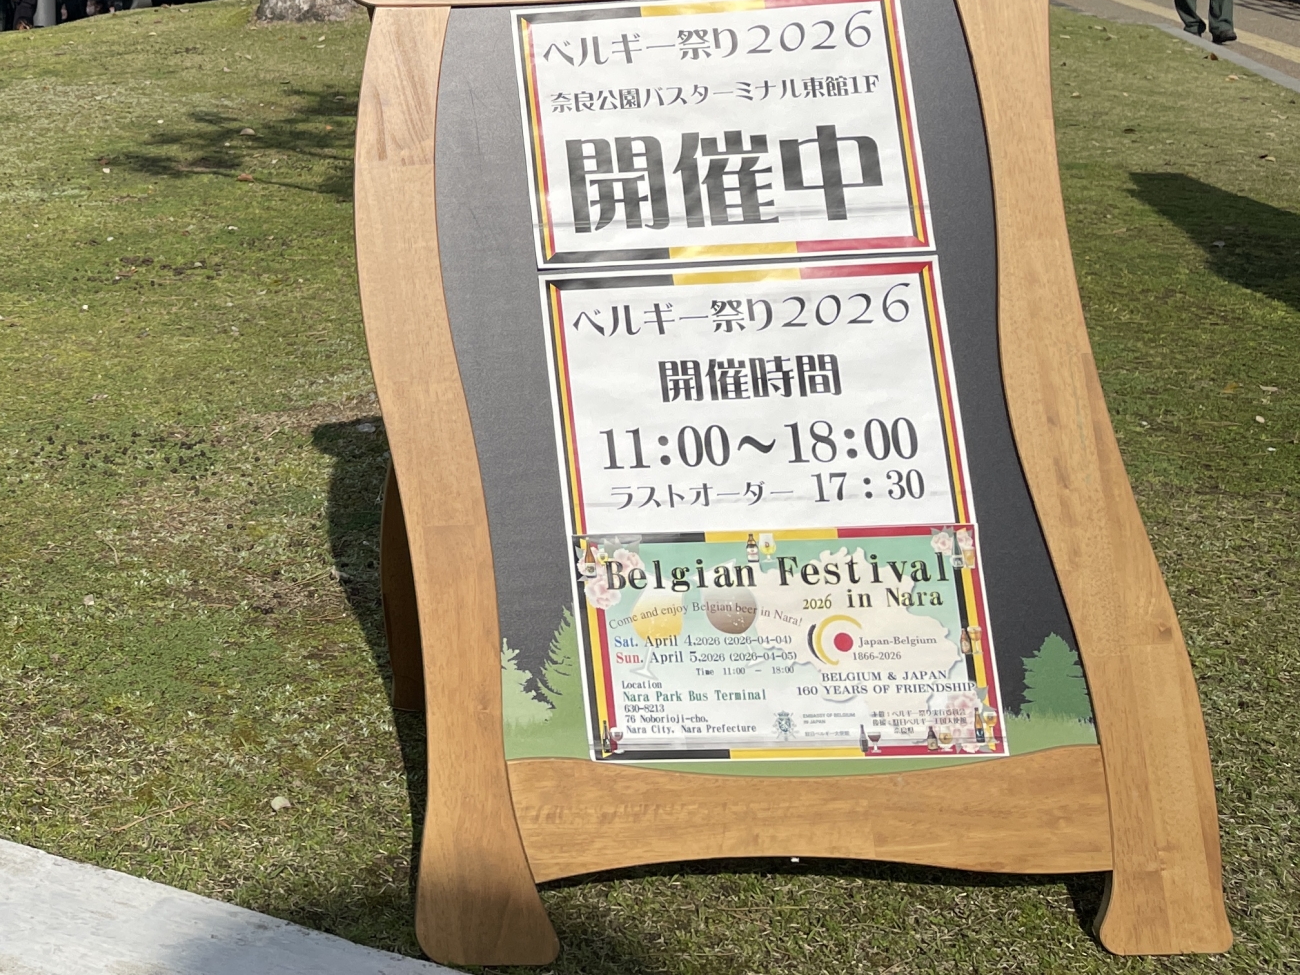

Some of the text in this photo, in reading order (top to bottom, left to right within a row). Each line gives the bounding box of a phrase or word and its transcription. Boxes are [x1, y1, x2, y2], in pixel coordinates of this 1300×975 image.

[543, 9, 874, 68] ベルギー祭り2026
[550, 75, 881, 114] 奈良公園バスターミナル東館1F
[565, 124, 884, 234] 開催中
[573, 282, 911, 338] ベルギー祭り2026
[658, 353, 843, 403] 開催時間
[610, 480, 794, 511] ラストオーダー
[605, 552, 950, 593] Belgian Festival
[802, 587, 944, 610] 2026 in Nara
[609, 613, 638, 630] Come
[641, 606, 659, 620] and
[661, 601, 689, 621] enjoy
[692, 600, 732, 614] Belgian
[735, 602, 758, 615] beer
[760, 606, 771, 617] in
[614, 635, 638, 648] Sat.
[644, 634, 678, 649] April
[858, 635, 938, 648] Japan-Belgium
[615, 651, 644, 664] Sun.
[649, 650, 684, 665] April
[852, 651, 902, 661] 1866-2026
[696, 667, 715, 676] Time
[722, 667, 746, 676] 11:00
[771, 666, 795, 675] 18:00
[822, 670, 948, 683] BELGIUM & JAPAN
[621, 680, 663, 690] Location
[797, 682, 976, 696] 160 YEARS OF FRIENDSHIP
[623, 688, 767, 702] Nara Park Bus Terminal
[624, 704, 665, 713] 630-8213
[625, 715, 636, 723] 76
[626, 725, 647, 734] Nara
[681, 724, 701, 734] Nara
[706, 723, 757, 733] Prefecture
